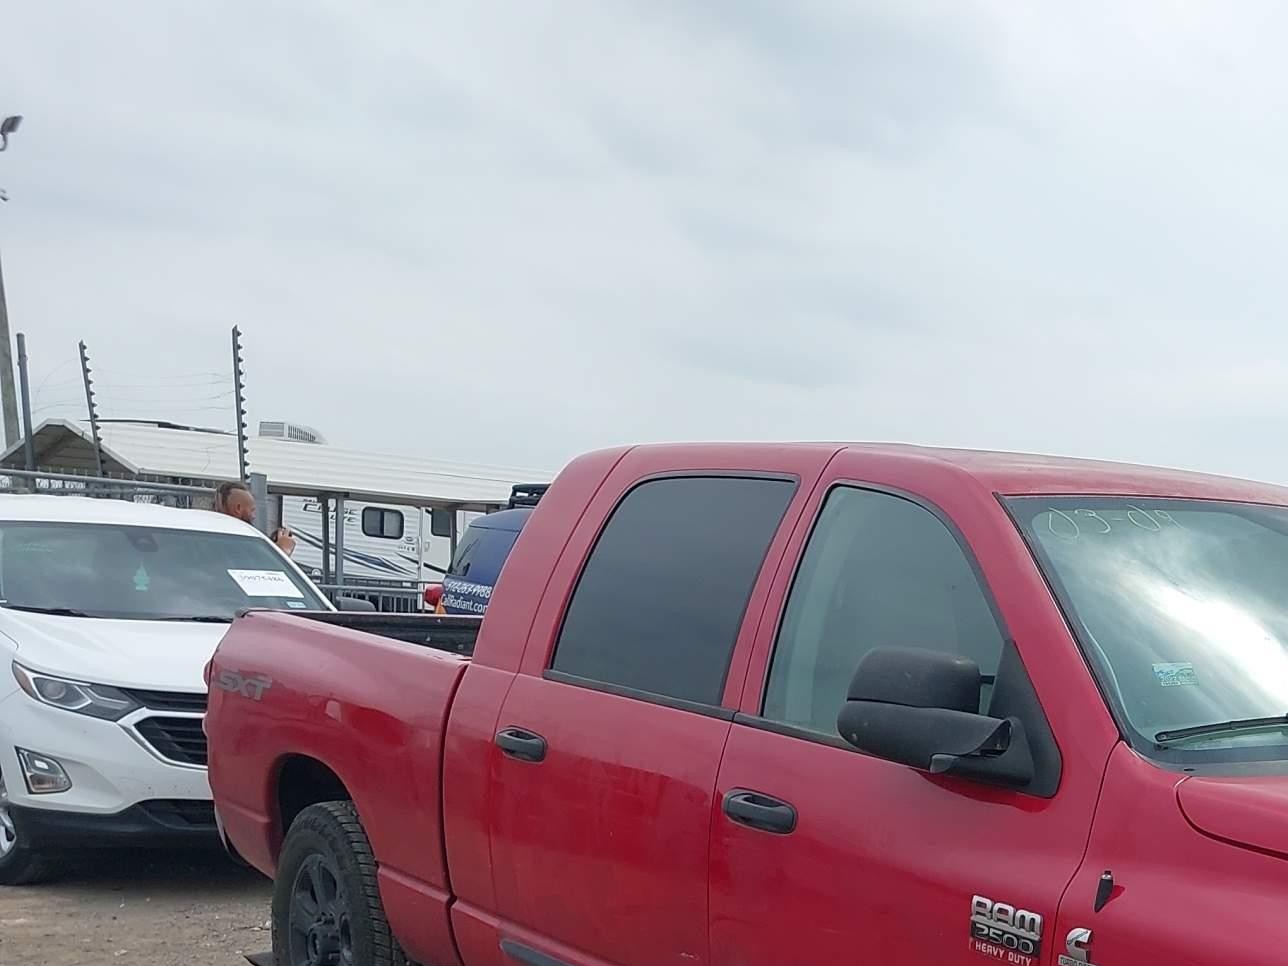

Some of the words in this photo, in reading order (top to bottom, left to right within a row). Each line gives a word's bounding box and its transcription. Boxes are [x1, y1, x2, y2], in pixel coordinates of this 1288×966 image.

[216, 669, 272, 701] SXT
[971, 895, 1043, 935] RAM
[974, 922, 1034, 954] 2500
[975, 941, 1005, 958] HEAVY
